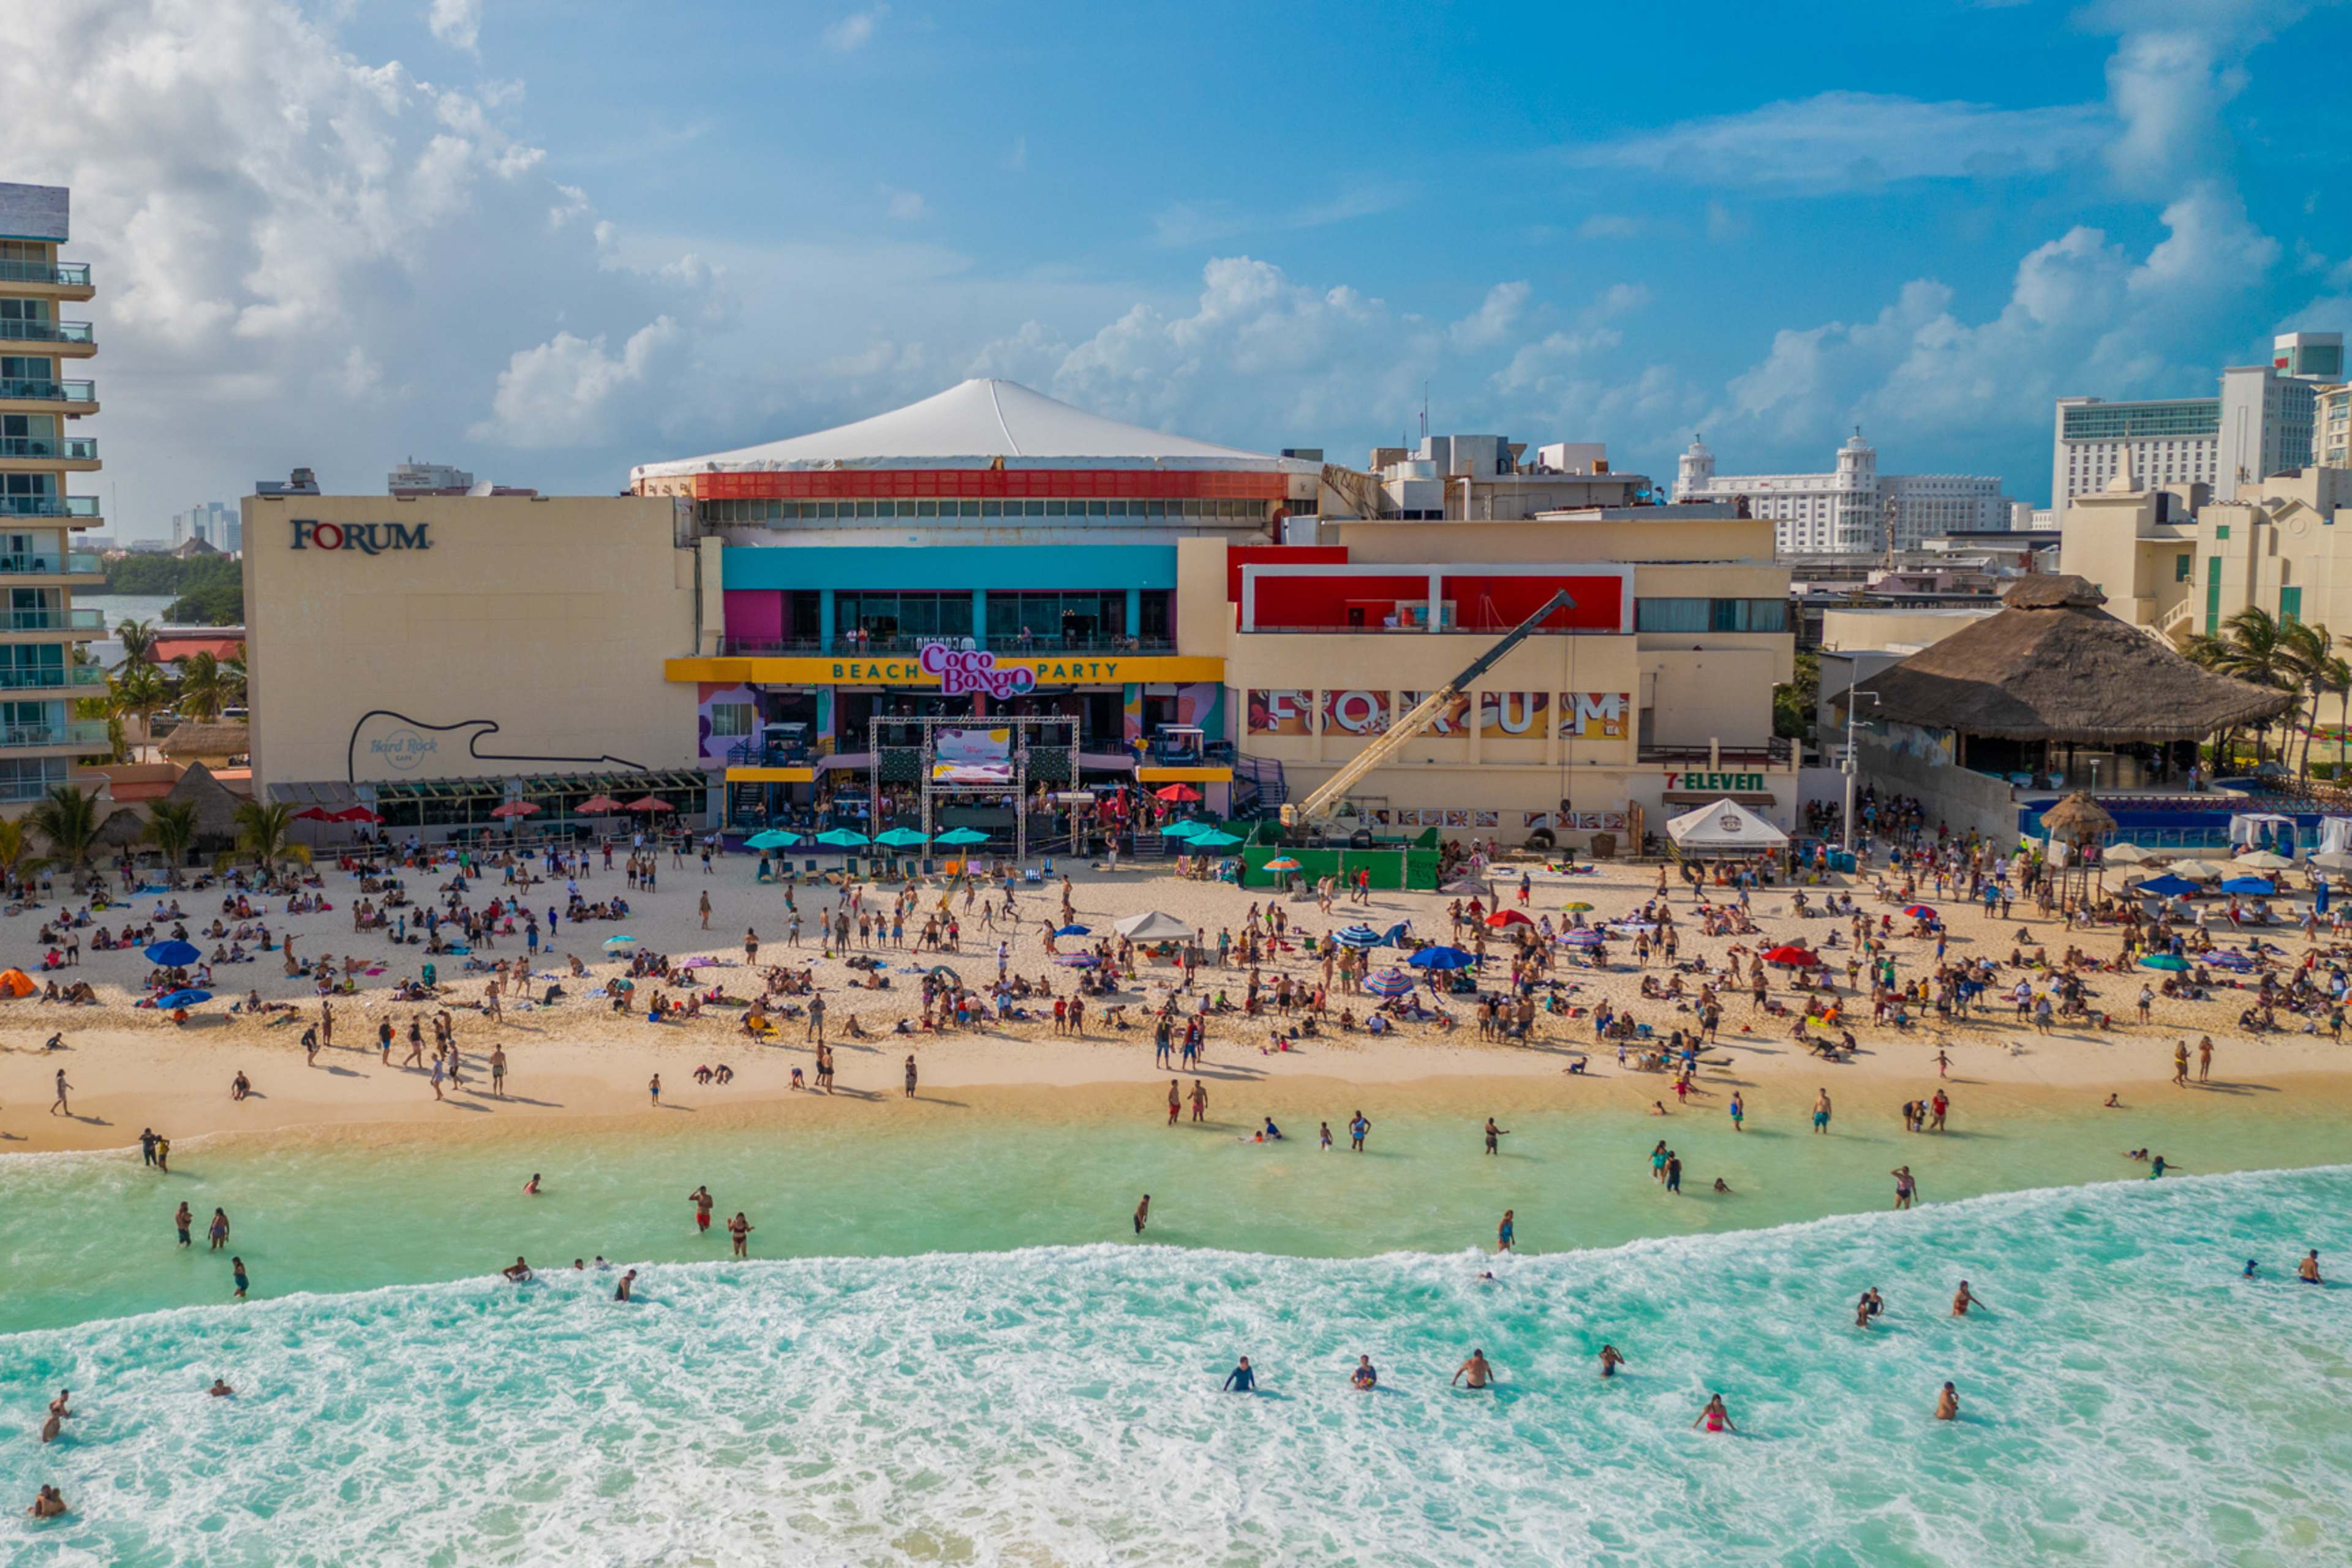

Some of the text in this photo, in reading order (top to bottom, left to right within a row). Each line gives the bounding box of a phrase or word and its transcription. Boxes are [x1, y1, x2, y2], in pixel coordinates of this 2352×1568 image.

[290, 519, 429, 555] FORUM
[833, 663, 1117, 678] BEACH PARTY
[371, 737, 438, 754] Hard Rock
